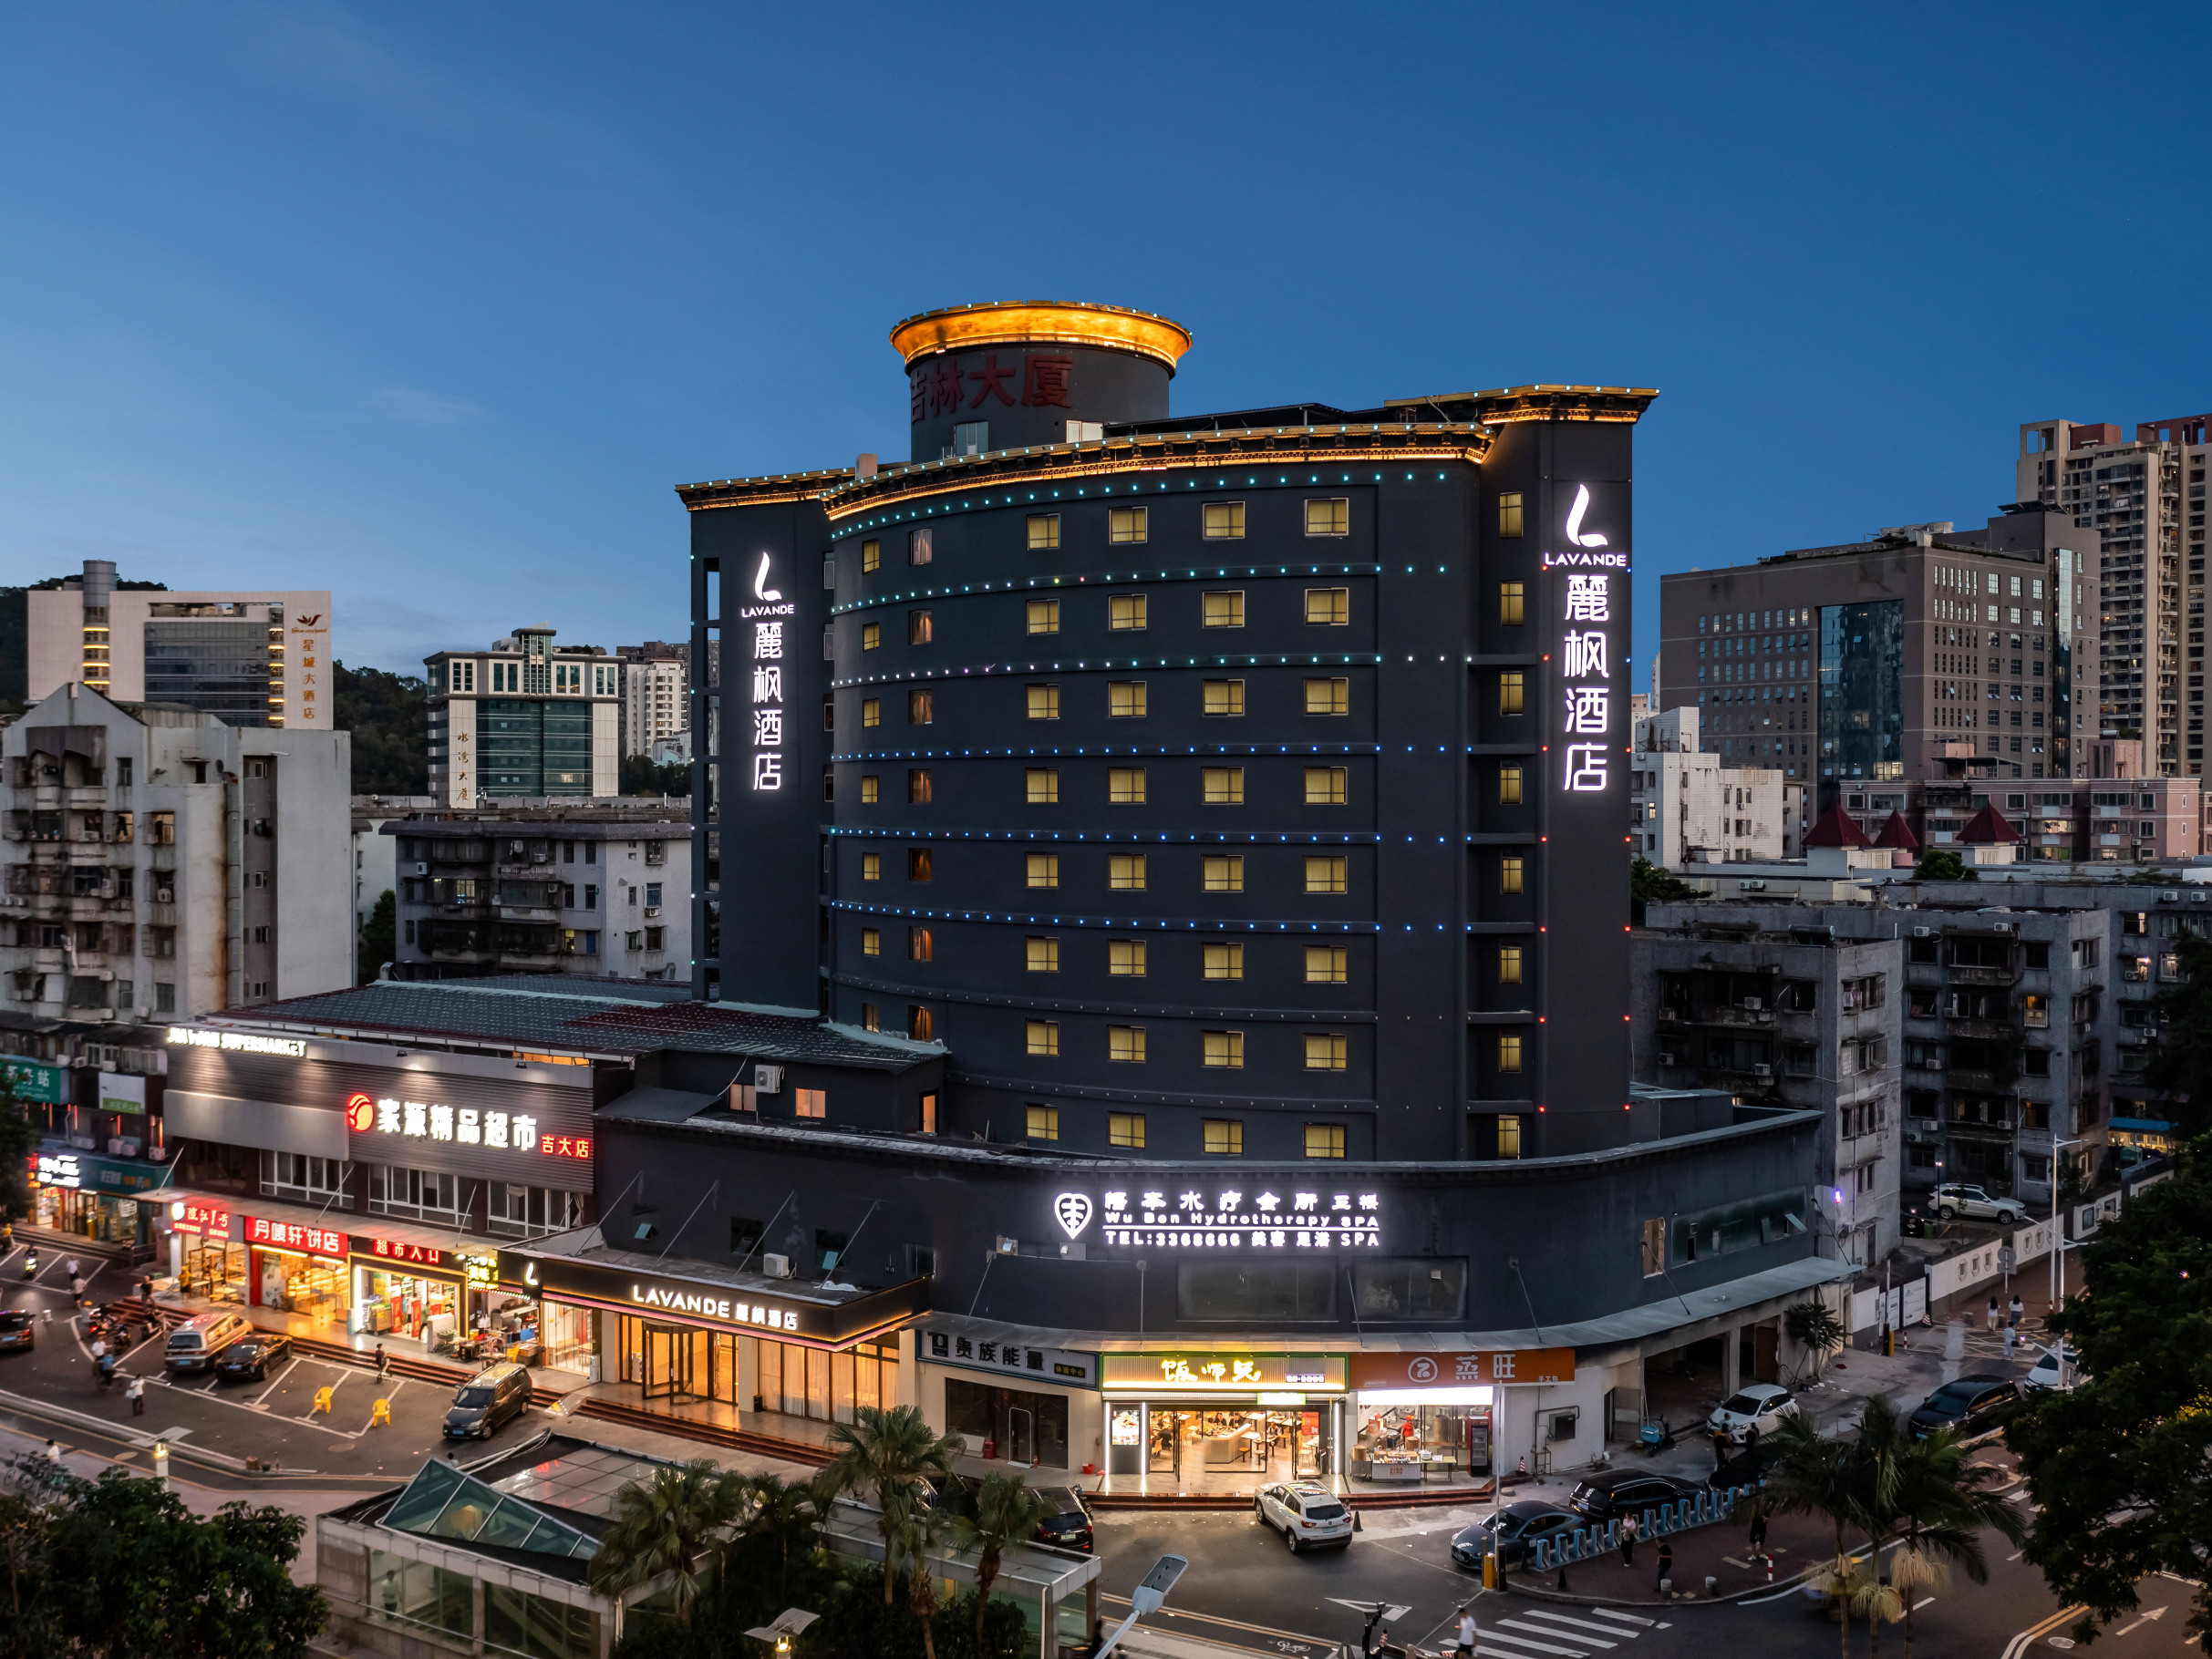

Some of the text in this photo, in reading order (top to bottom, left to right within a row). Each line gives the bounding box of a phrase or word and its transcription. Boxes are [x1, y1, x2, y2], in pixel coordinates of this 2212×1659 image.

[911, 352, 1072, 425] 吉林大厦
[1545, 552, 1627, 567] LAVANDE
[741, 604, 794, 618] LAVANDE
[221, 1033, 306, 1057] SUPERMARKET
[377, 1098, 537, 1151] 家源精品超市
[541, 1135, 590, 1159] 吉大店
[1105, 1211, 1132, 1223] Wu
[1191, 1212, 1329, 1227] Hydrotherapy
[1340, 1216, 1379, 1227] SPA
[376, 1239, 439, 1263] 超市入口
[1340, 1232, 1379, 1246] SPA
[633, 1284, 729, 1318] LAVANDE
[956, 1336, 1044, 1371] 贵族能量
